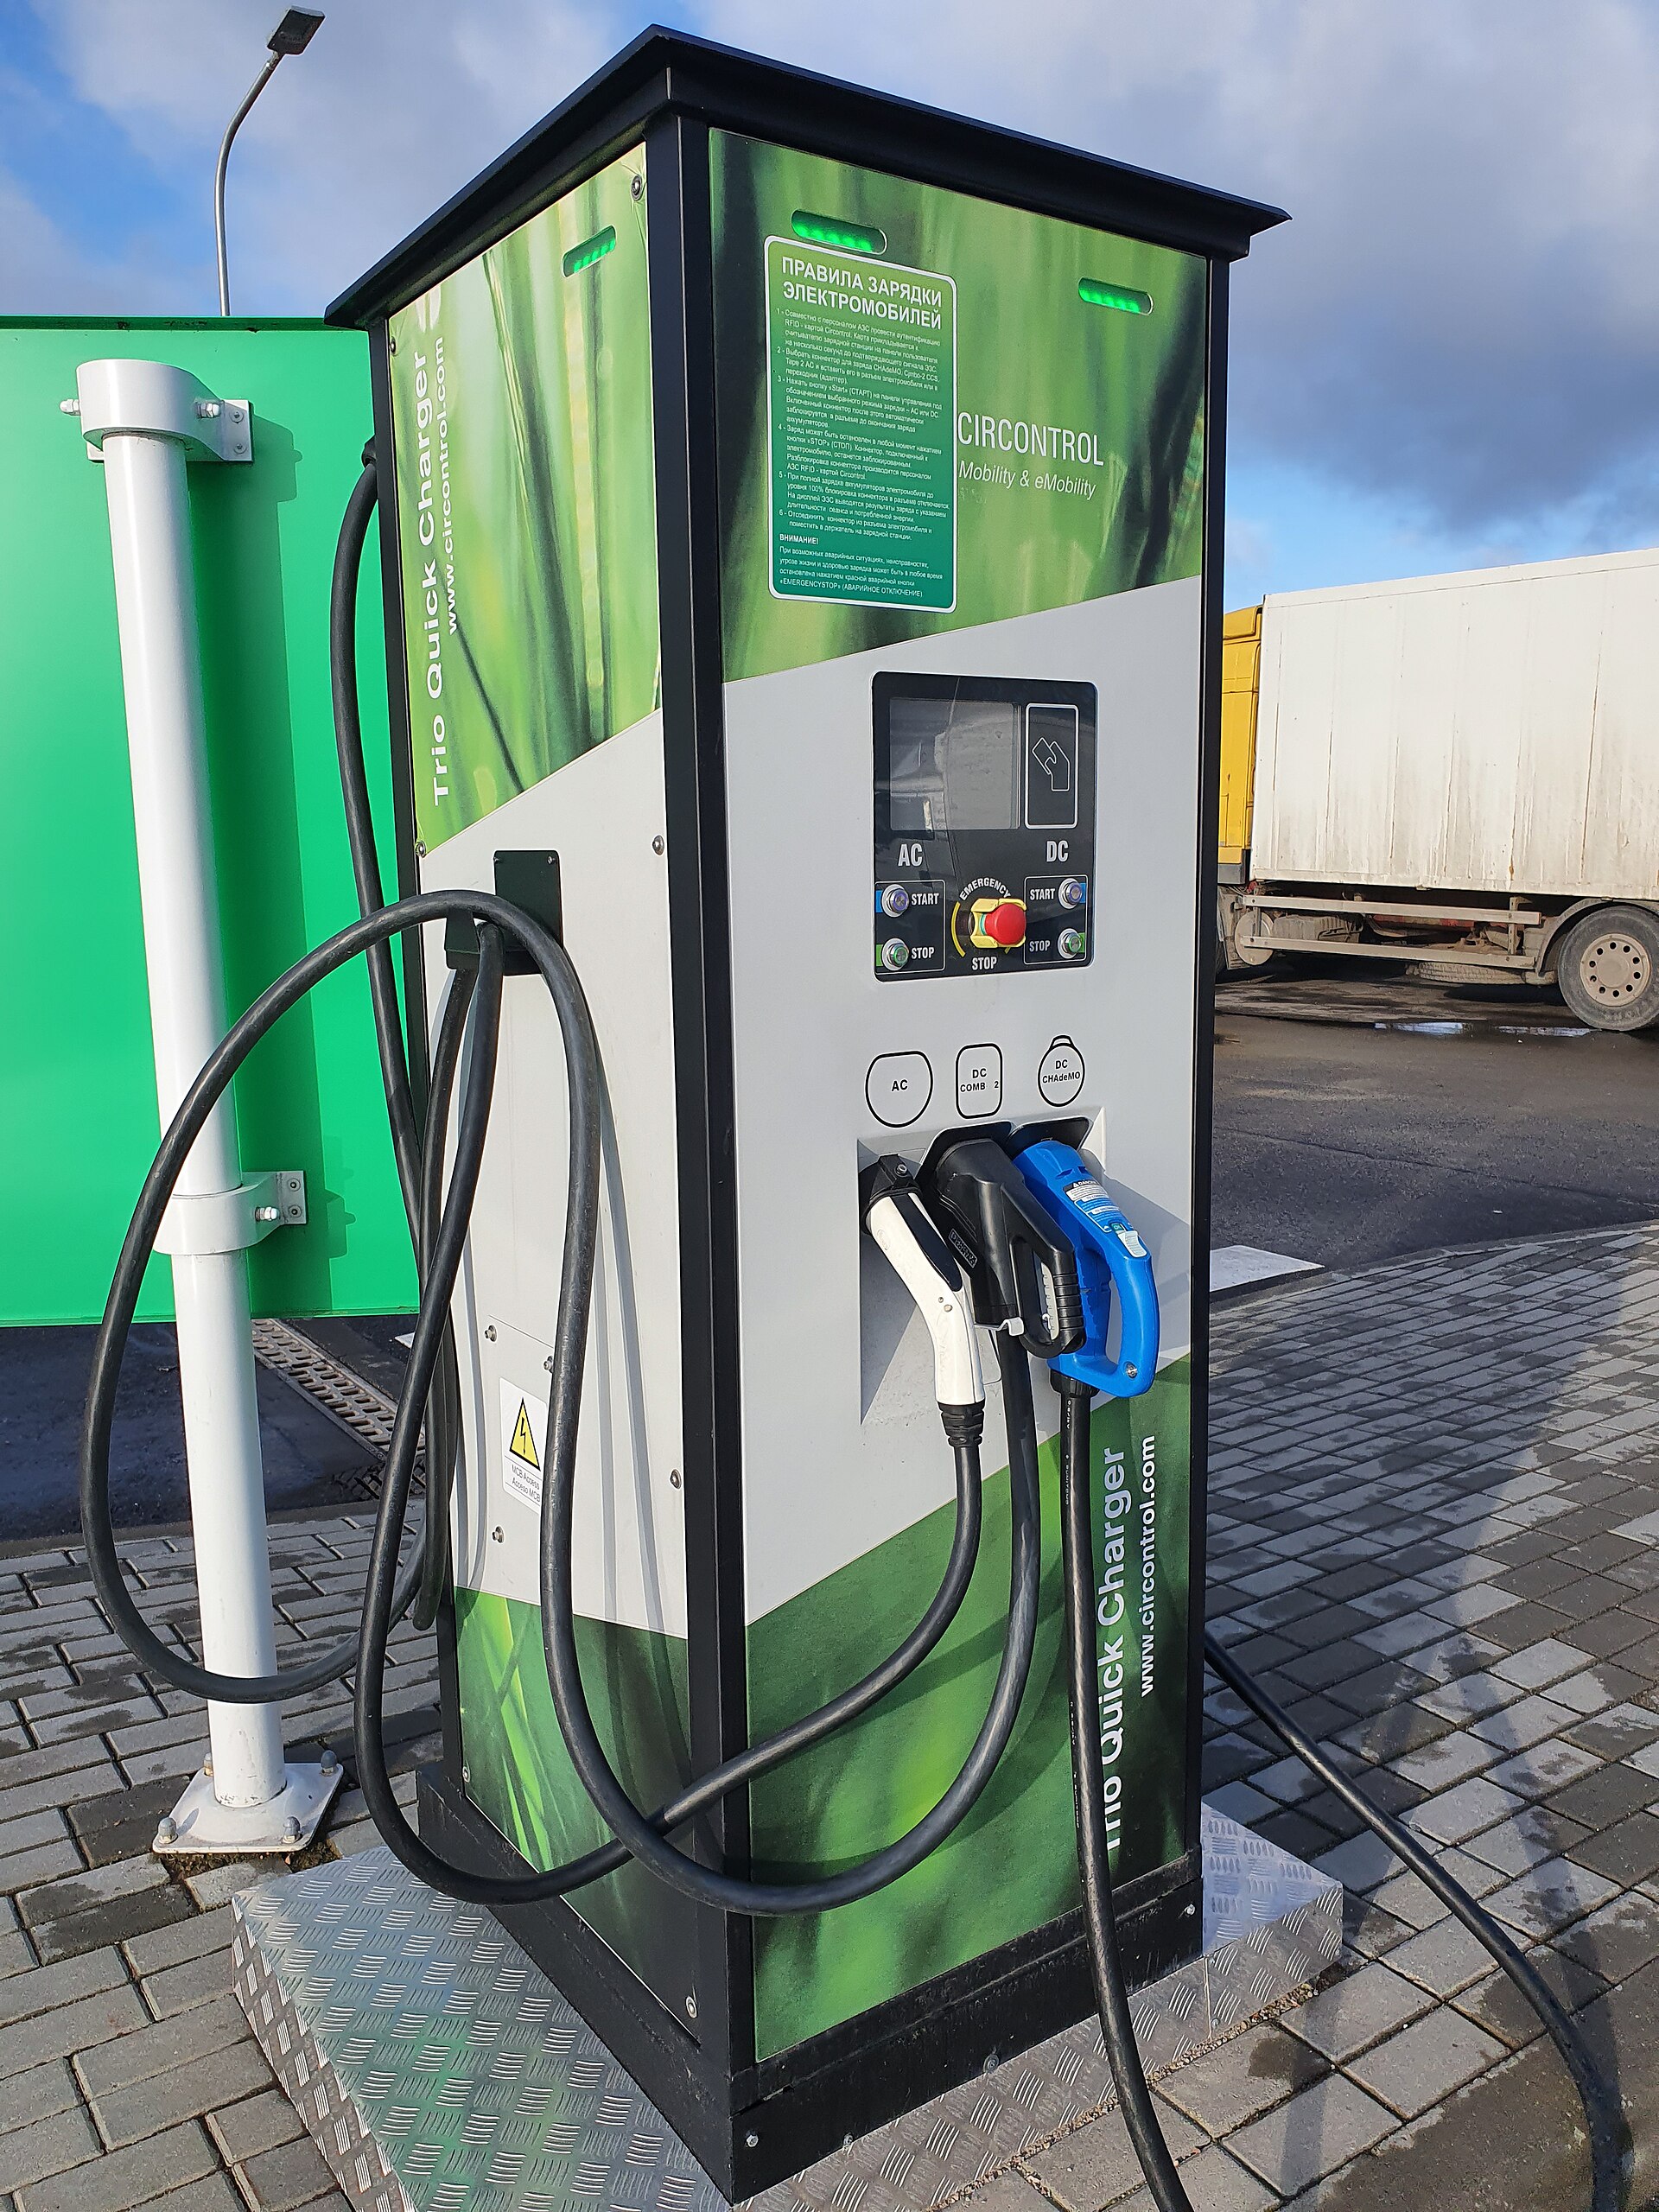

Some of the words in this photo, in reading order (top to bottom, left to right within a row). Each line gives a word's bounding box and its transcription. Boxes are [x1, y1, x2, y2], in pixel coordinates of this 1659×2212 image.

[782, 257, 863, 290] ПРАВИЛА
[868, 276, 942, 308] ЗАРЯДКИ
[783, 282, 941, 330] ЭЛЕКТРОМОБИЛЕЙ
[785, 318, 799, 327] RFID
[785, 347, 810, 359] Выбрать
[824, 430, 838, 439] быть
[957, 411, 1104, 467] CIRCONTROL
[415, 351, 435, 546] Charger
[787, 472, 798, 480] При
[959, 461, 1015, 489] Mobility
[1020, 470, 1030, 487] &
[1035, 473, 1096, 500] eMobility
[435, 337, 456, 634] www.circontrol.com
[808, 484, 823, 493] 100%
[779, 533, 818, 544] ВНИМАНИЕ!
[779, 545, 791, 554] При
[422, 558, 442, 699] Quick
[432, 715, 448, 805] Trio
[898, 843, 923, 867] AC
[1046, 840, 1069, 862] DC
[959, 877, 1012, 901] EMERGENCY
[1030, 888, 1056, 900] START
[911, 893, 939, 906] START
[1030, 940, 1051, 952] STOP
[911, 947, 935, 959] STOP
[971, 957, 997, 970] STOP
[1055, 1059, 1068, 1070] DC
[972, 1068, 987, 1078] DC
[1042, 1071, 1080, 1084] CHAdeMO
[892, 1080, 908, 1092] AC
[960, 1083, 985, 1092] COMB
[512, 1464, 523, 1478] MCB
[524, 1472, 539, 1490] Access
[512, 1478, 528, 1493] Acceso
[529, 1488, 541, 1502] MCB
[1097, 1448, 1132, 1626] Charger
[1139, 1435, 1155, 1697] www.circontrol.com
[1097, 1635, 1123, 1764] Quick
